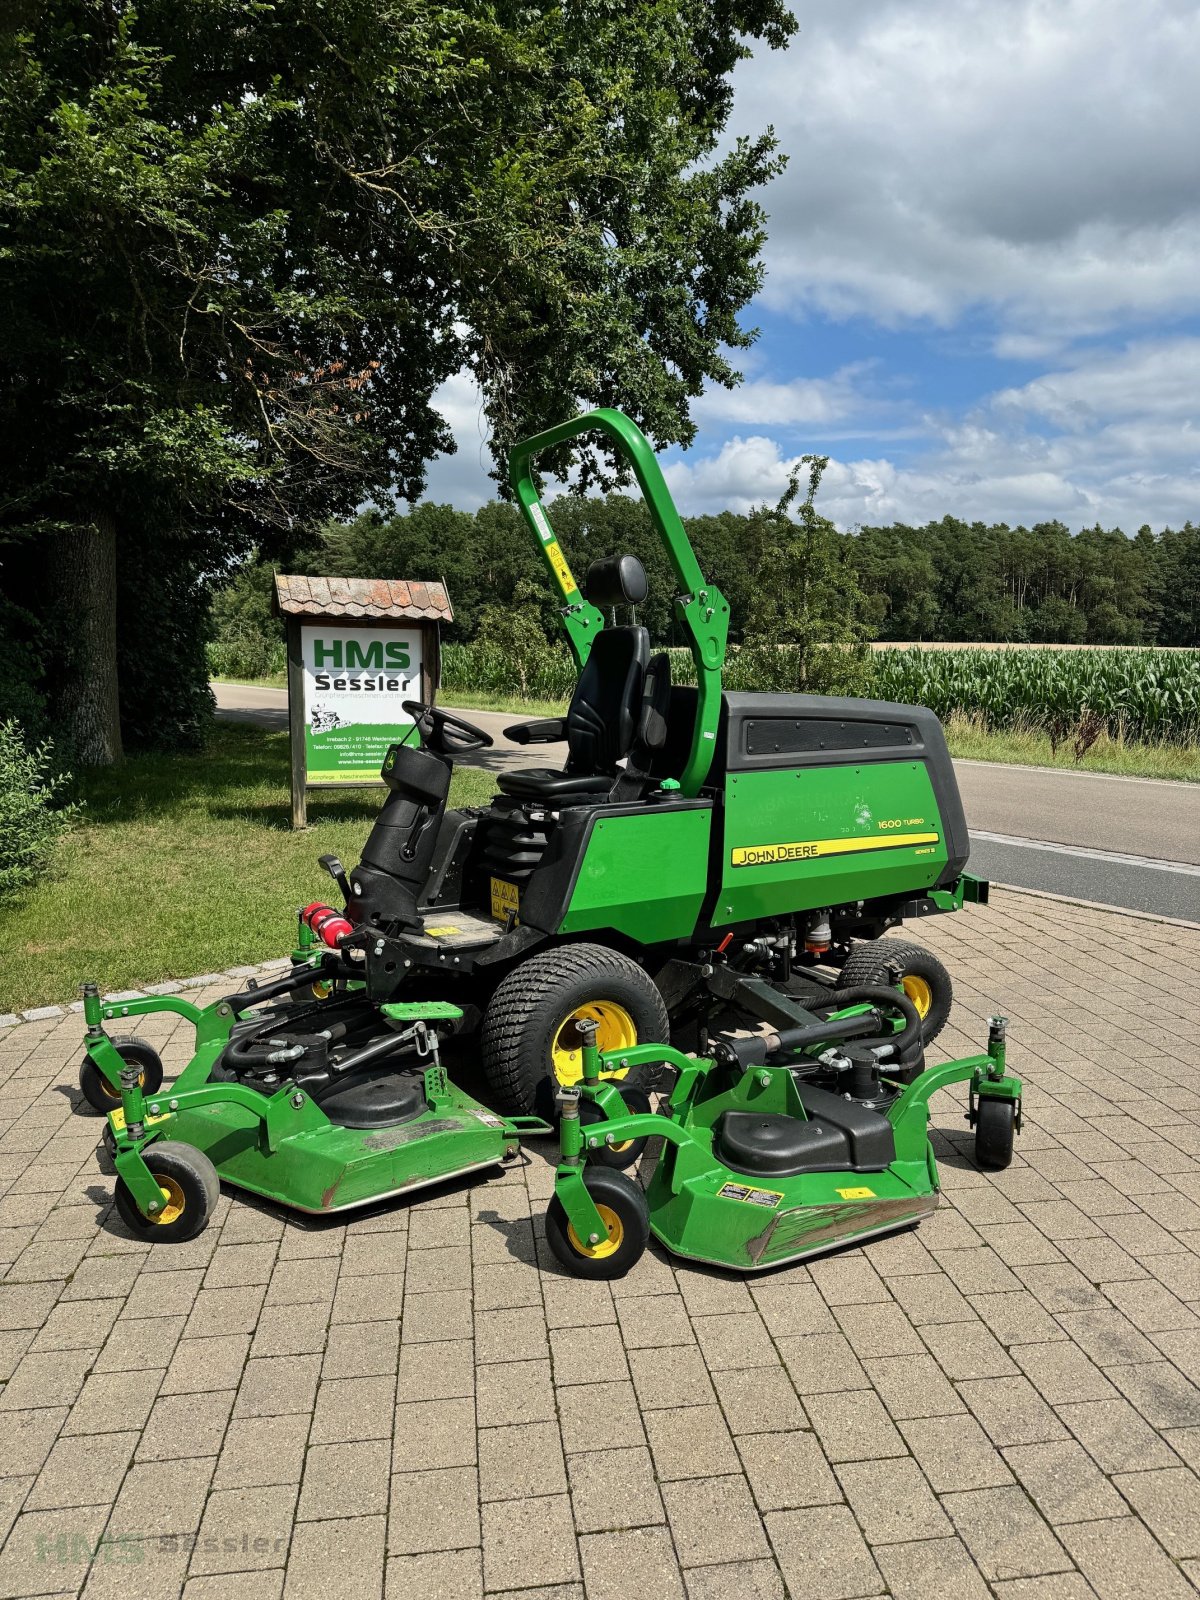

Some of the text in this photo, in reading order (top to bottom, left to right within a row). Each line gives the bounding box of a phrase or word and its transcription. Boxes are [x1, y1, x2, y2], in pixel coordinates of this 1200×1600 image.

[314, 639, 411, 669] HMS
[315, 675, 411, 691] Sessler
[878, 818, 925, 829] 1600 TURBO
[739, 845, 819, 864] JOHN DEERE
